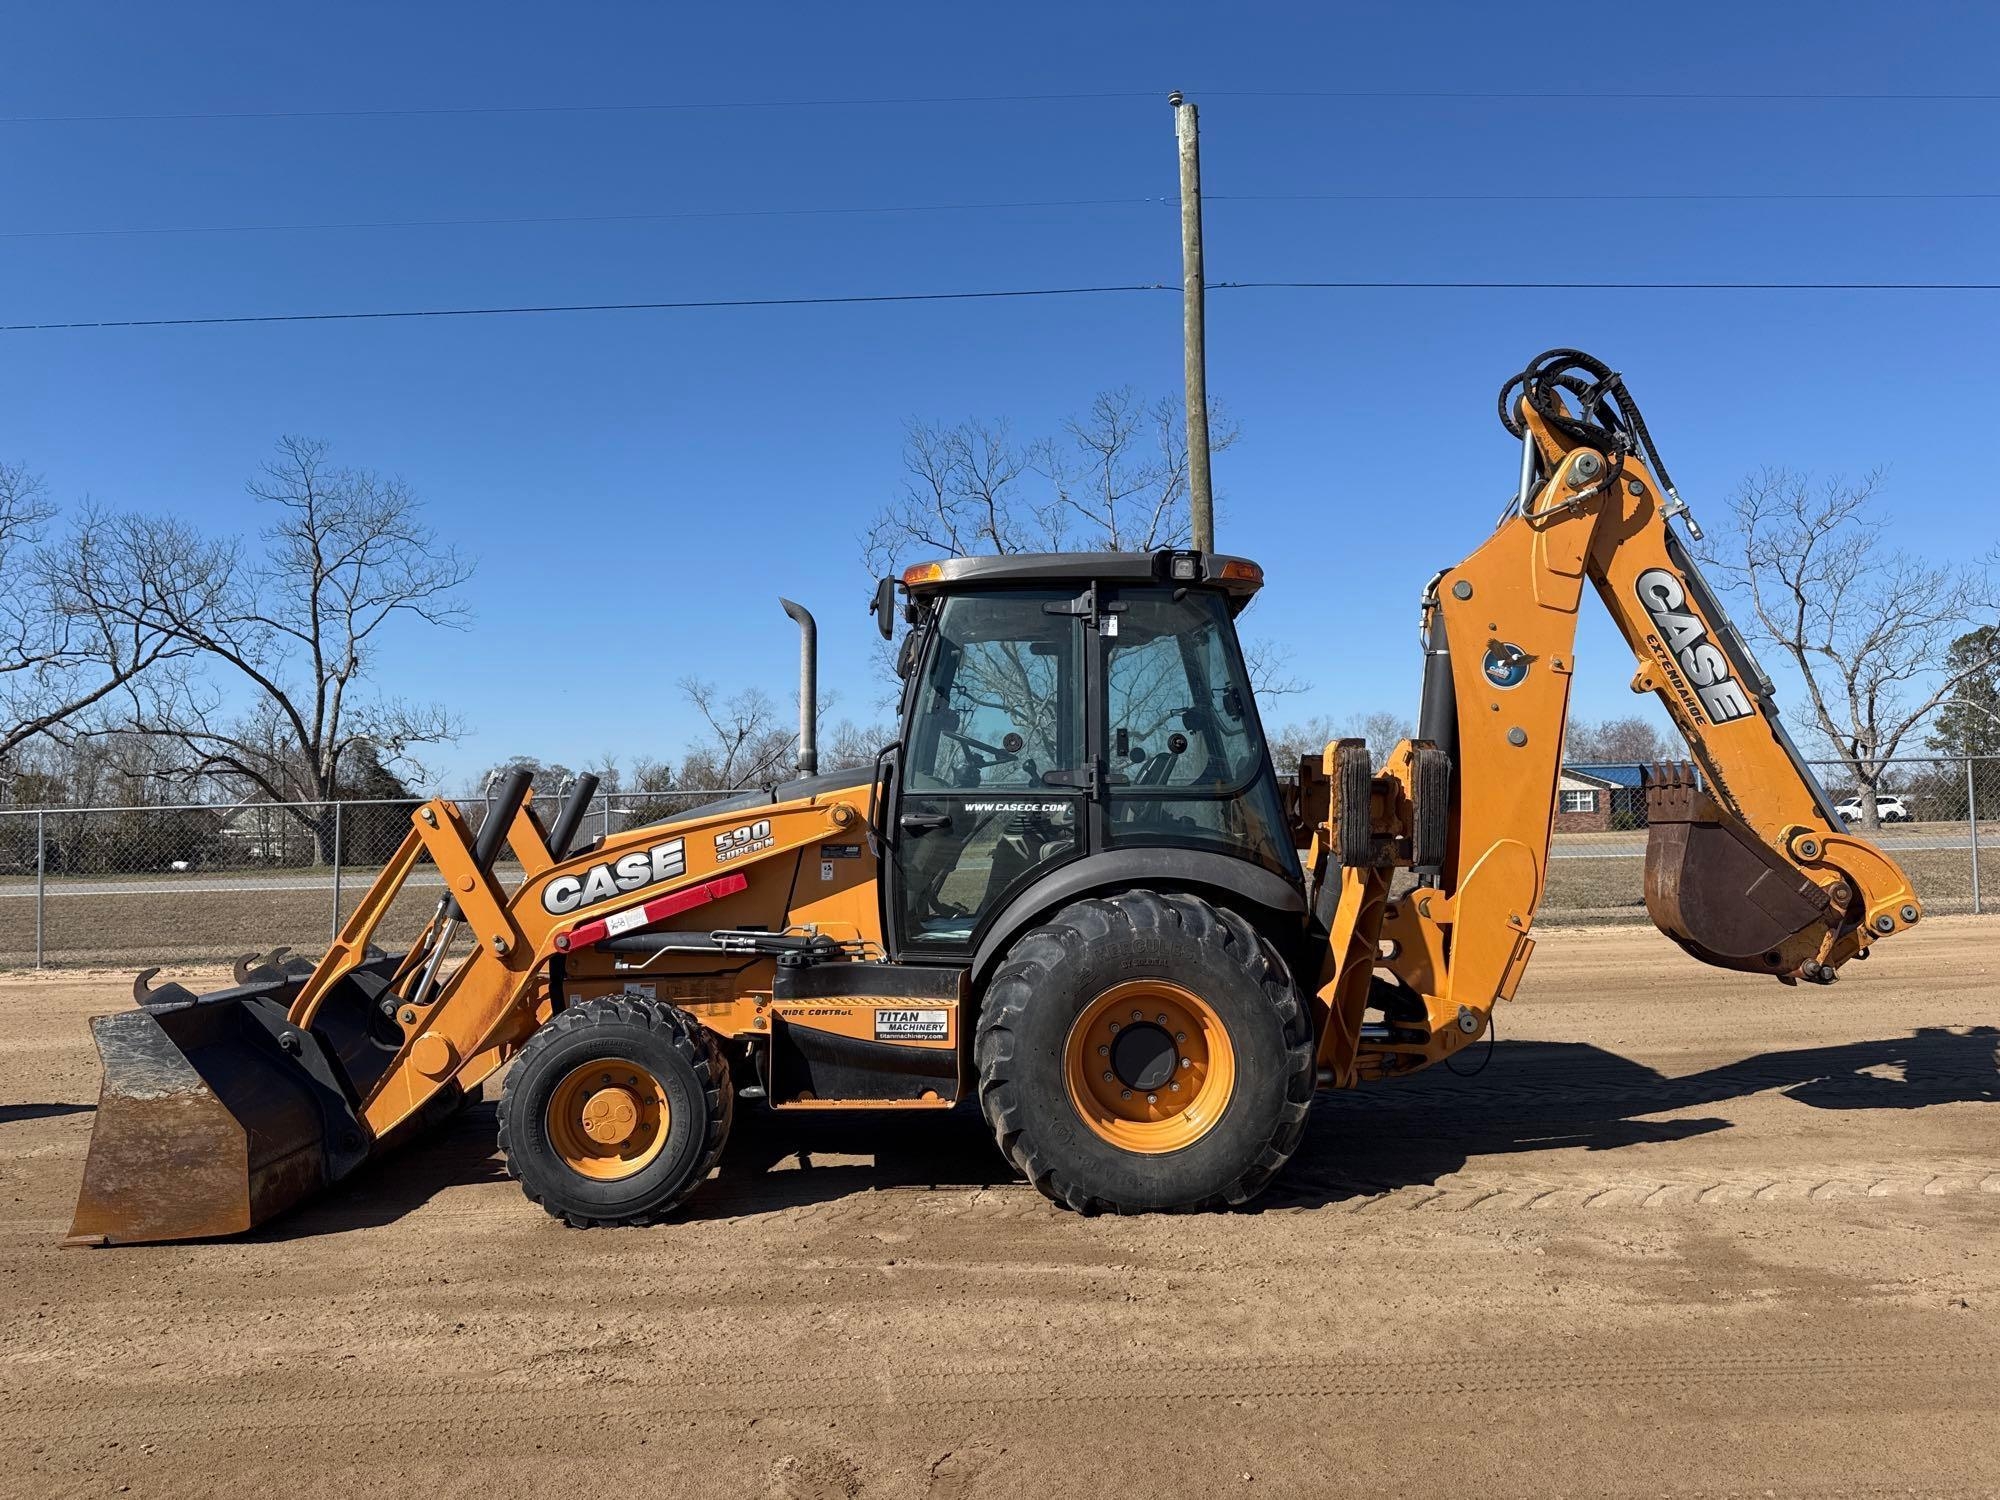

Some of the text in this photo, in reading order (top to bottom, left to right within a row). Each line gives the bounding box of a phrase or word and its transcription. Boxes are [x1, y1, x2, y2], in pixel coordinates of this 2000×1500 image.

[1637, 569, 1755, 724] CASE
[1646, 634, 1707, 726] EXTENDAHOE
[965, 803, 1067, 812] WWW.CASECE.COM
[714, 819, 770, 853] 590
[716, 836, 774, 863] SUPER N
[543, 837, 686, 914] CASE
[879, 1012, 919, 1022] TITAN
